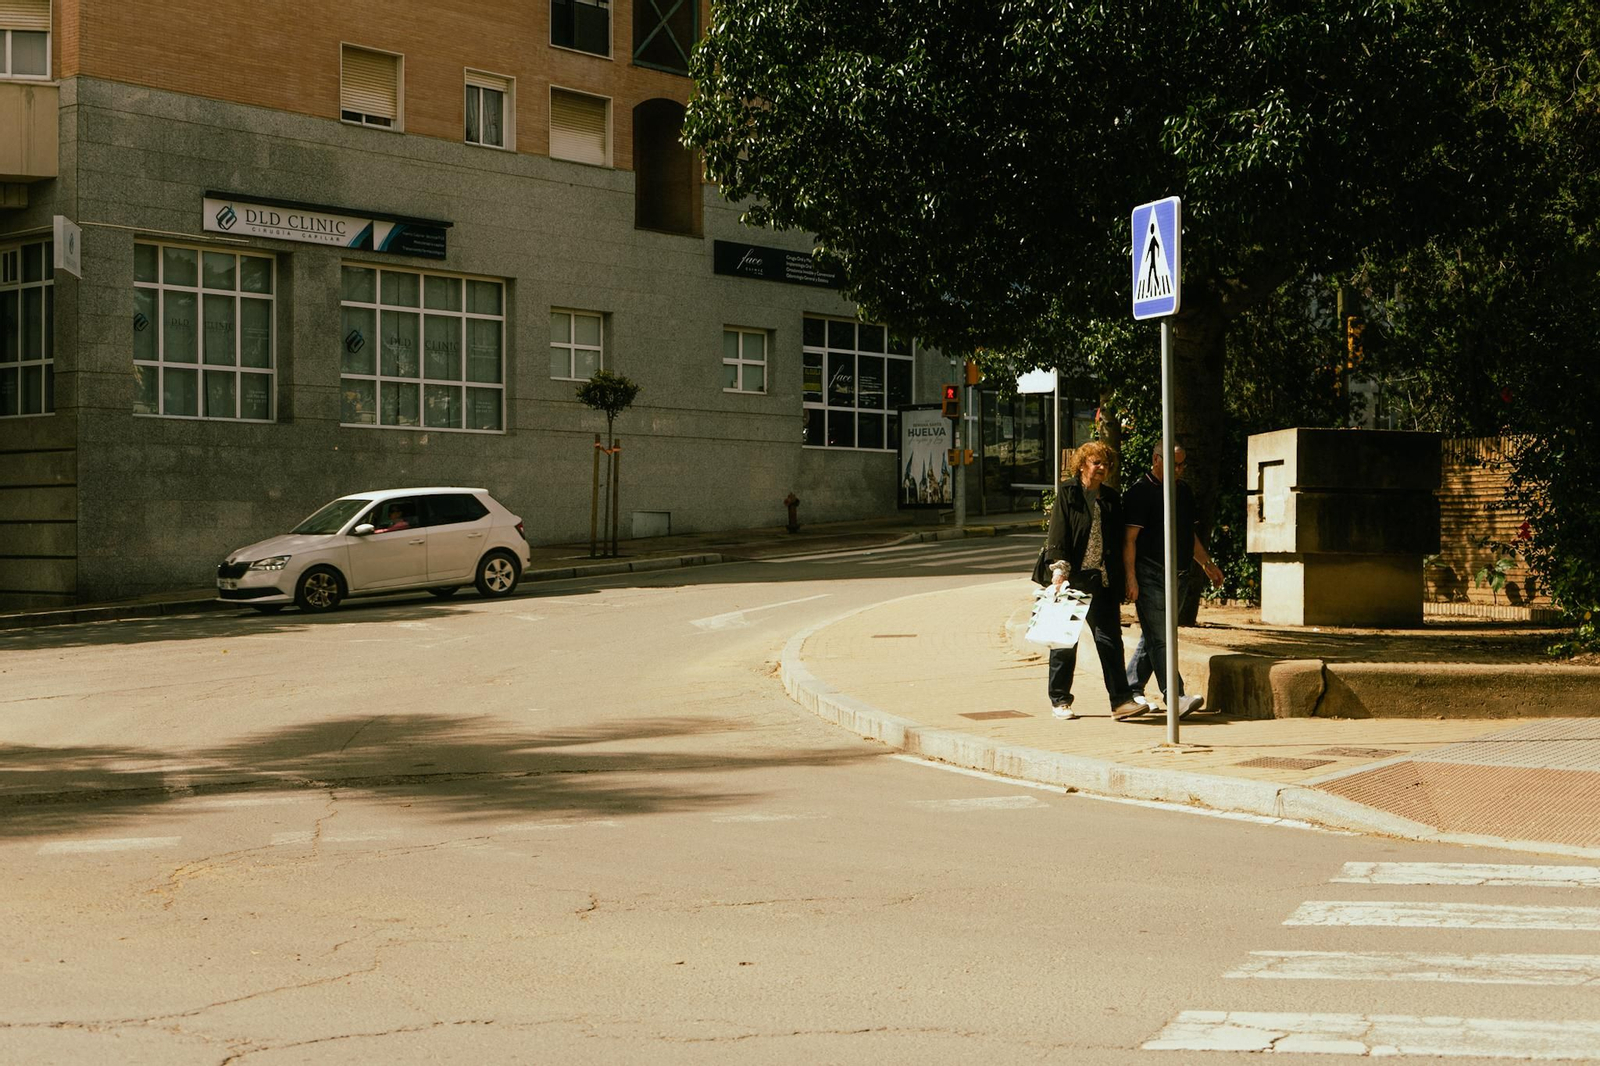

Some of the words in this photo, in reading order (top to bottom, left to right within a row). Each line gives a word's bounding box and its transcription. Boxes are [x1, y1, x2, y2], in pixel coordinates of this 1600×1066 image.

[245, 209, 281, 226] DLD
[288, 215, 346, 234] CLINIC
[301, 233, 340, 242] CAPILAR
[736, 248, 763, 270] face
[171, 318, 190, 326] DLD
[205, 321, 234, 331] CLINIC
[390, 337, 412, 347] DLD
[425, 341, 459, 351] CLINIC
[828, 364, 853, 388] face
[907, 427, 946, 437] HUELVA
